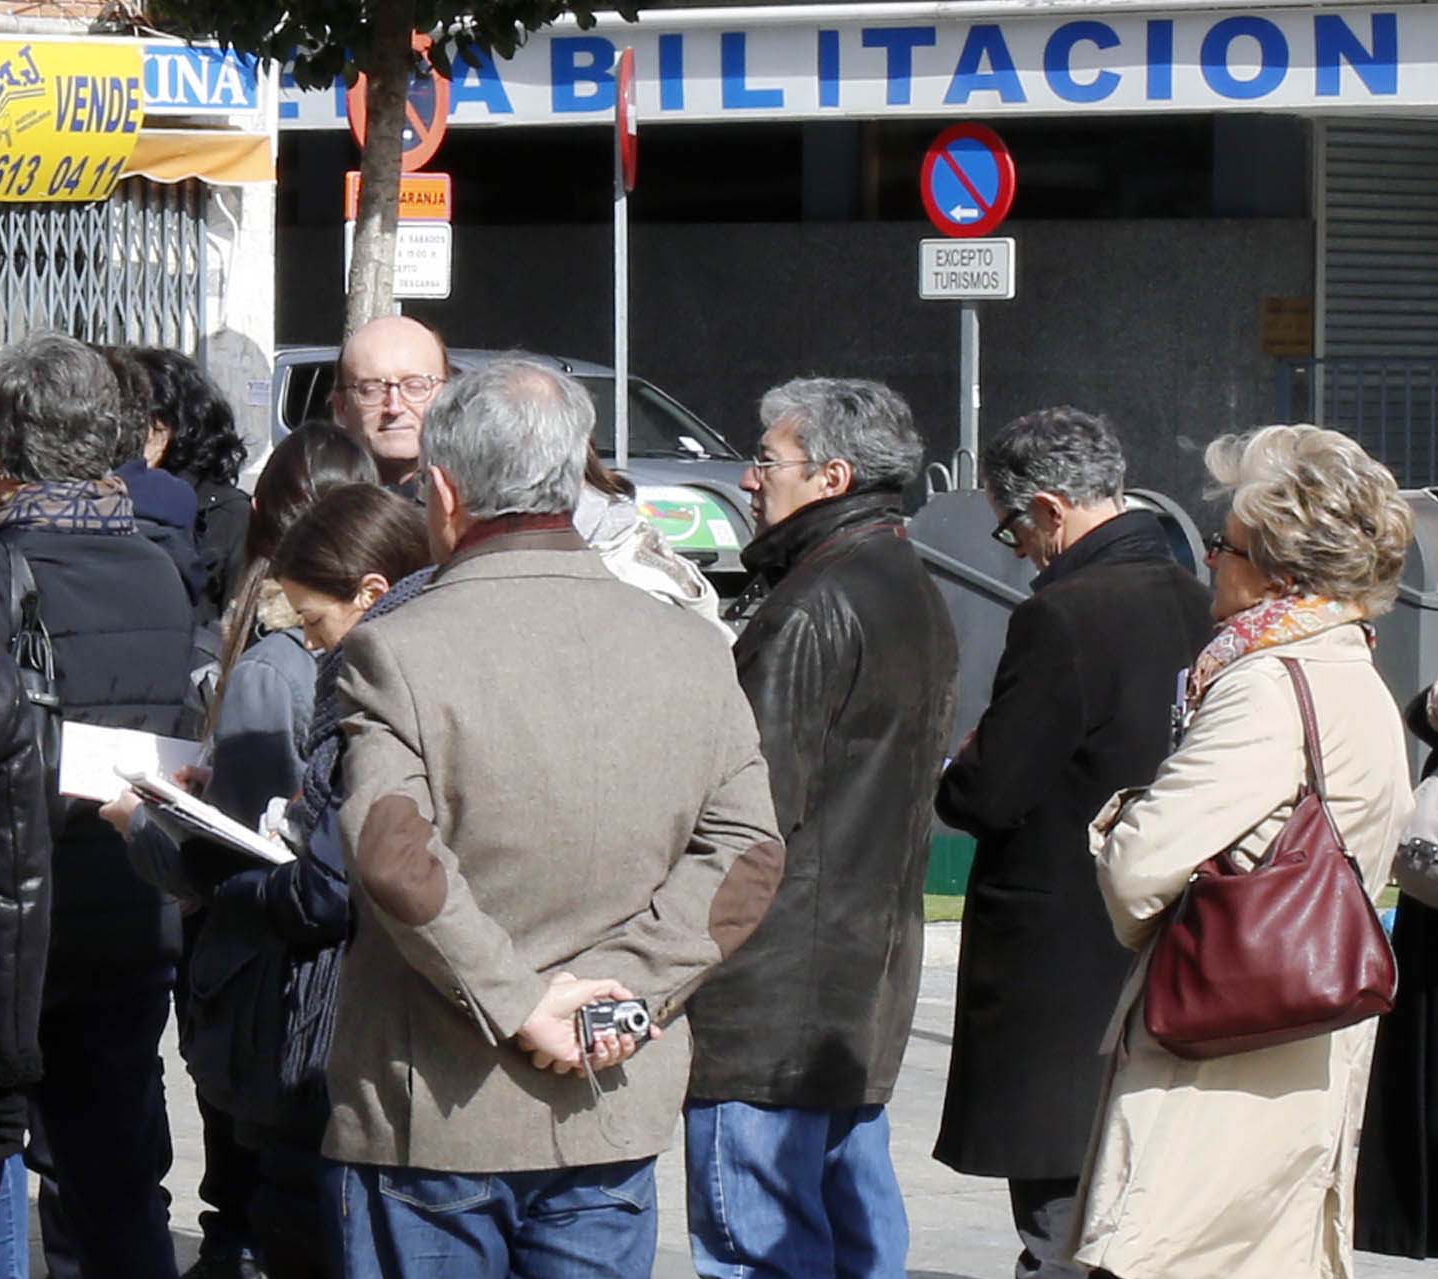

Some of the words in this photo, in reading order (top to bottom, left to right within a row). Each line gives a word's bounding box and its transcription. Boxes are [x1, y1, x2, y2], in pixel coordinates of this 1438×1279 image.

[55, 76, 140, 133] VENDE
[48, 155, 89, 196] 04
[89, 155, 127, 195] 11
[399, 192, 446, 205] ARANJA
[935, 249, 993, 267] EXCEPTO
[932, 272, 999, 290] TURISMOS
